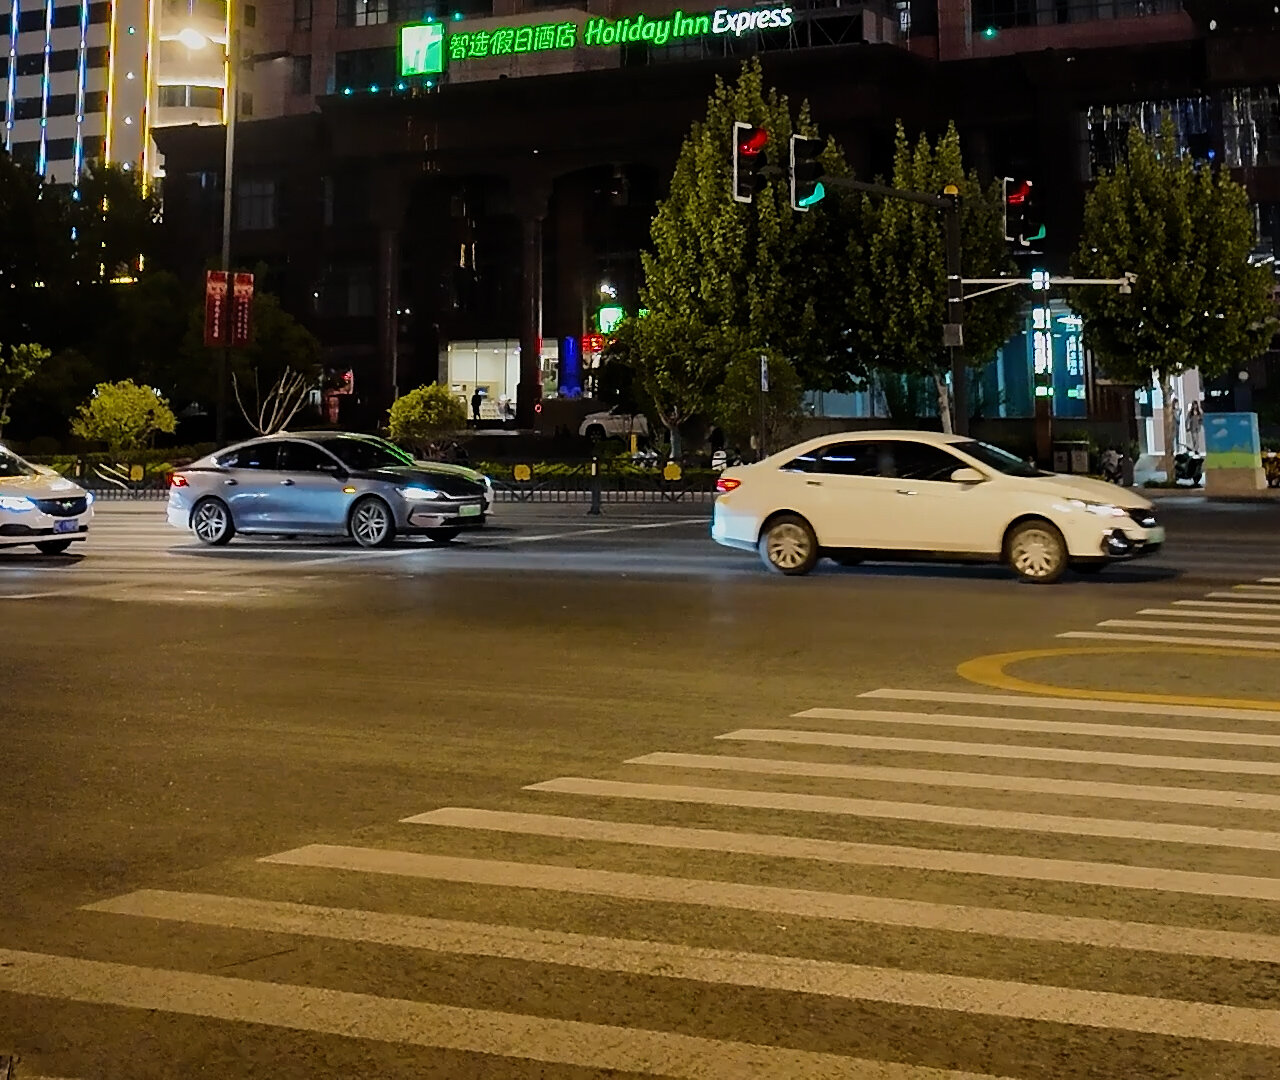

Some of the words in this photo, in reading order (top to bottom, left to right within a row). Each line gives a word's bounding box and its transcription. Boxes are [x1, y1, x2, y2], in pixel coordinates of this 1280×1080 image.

[450, 22, 577, 59] 智选假日酒店
[585, 14, 670, 45] Holiday
[672, 10, 710, 37] Inn
[712, 7, 793, 37] Express
